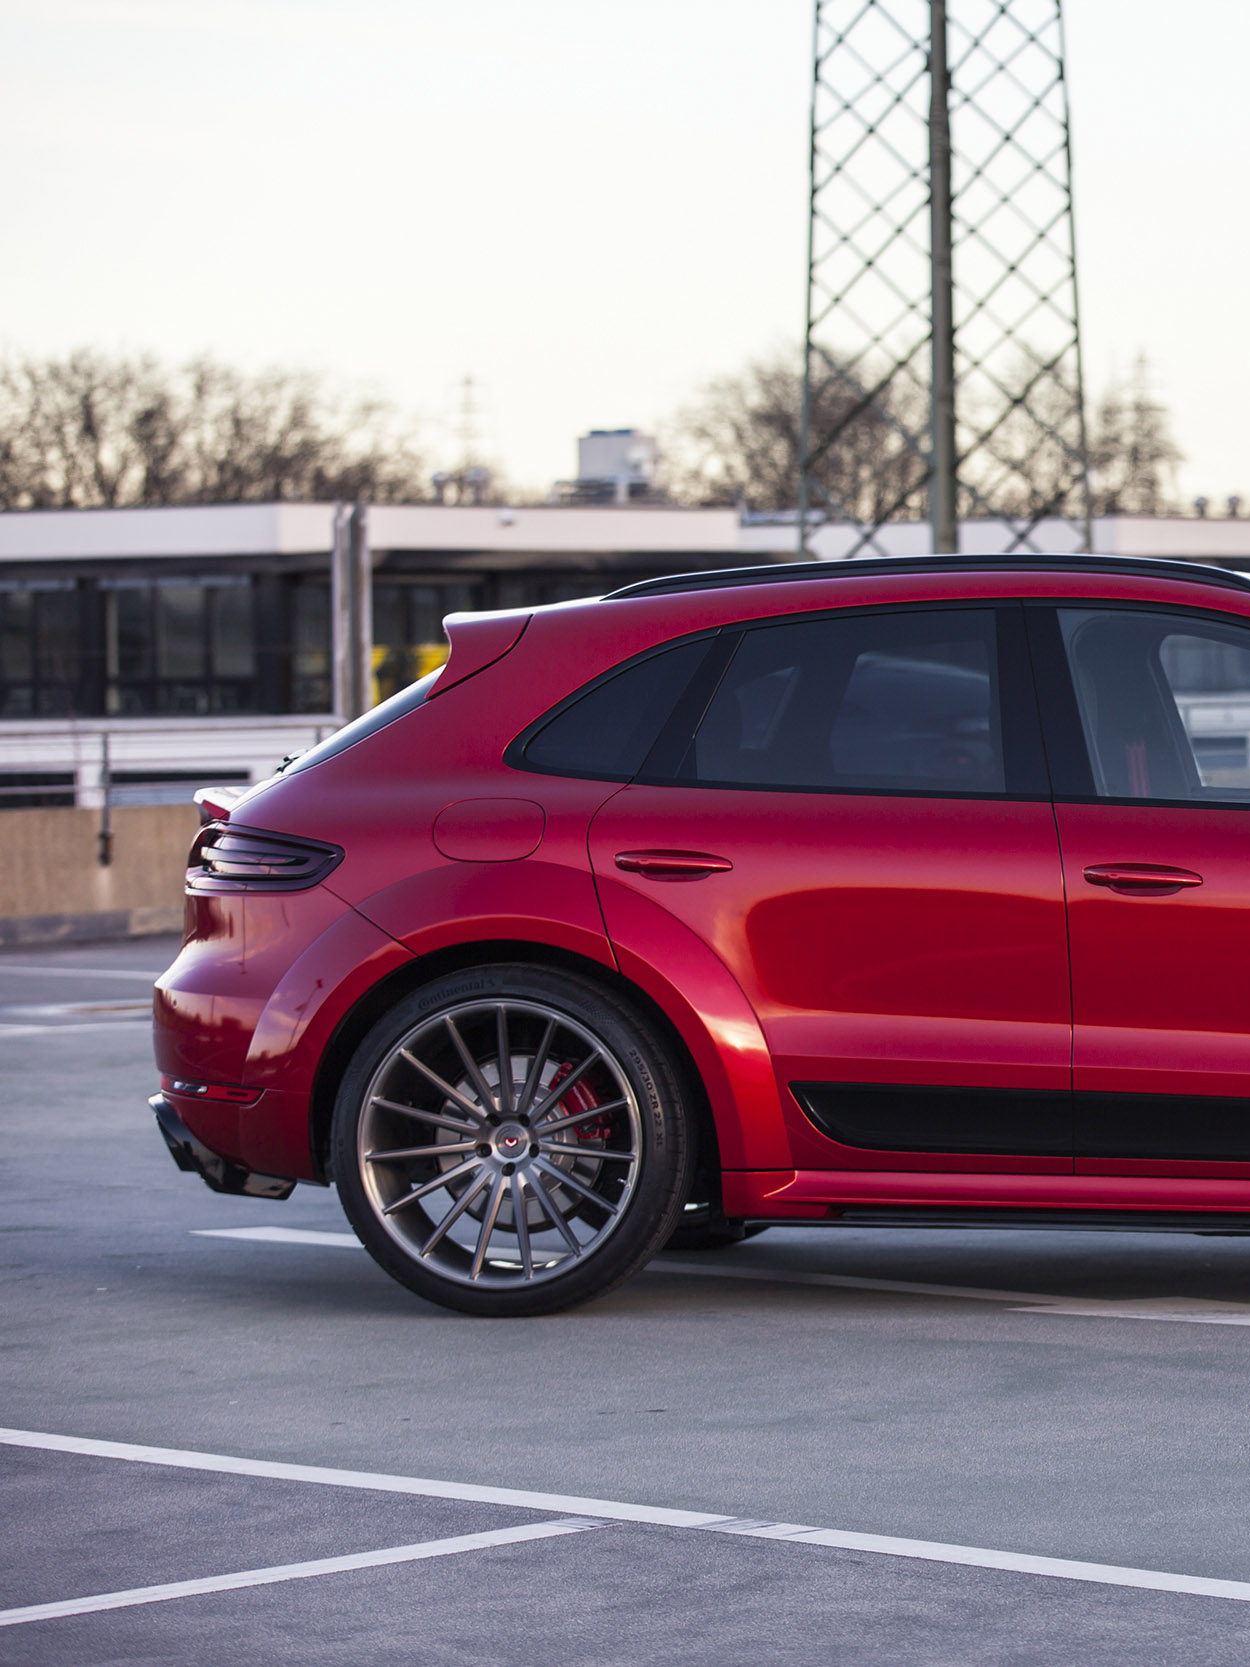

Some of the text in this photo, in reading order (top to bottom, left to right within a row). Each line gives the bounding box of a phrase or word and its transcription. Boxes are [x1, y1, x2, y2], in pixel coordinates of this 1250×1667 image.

[419, 979, 484, 1010] Continental
[629, 1050, 653, 1091] 295/30
[649, 1094, 659, 1109] ZR
[654, 1112, 663, 1127] 22
